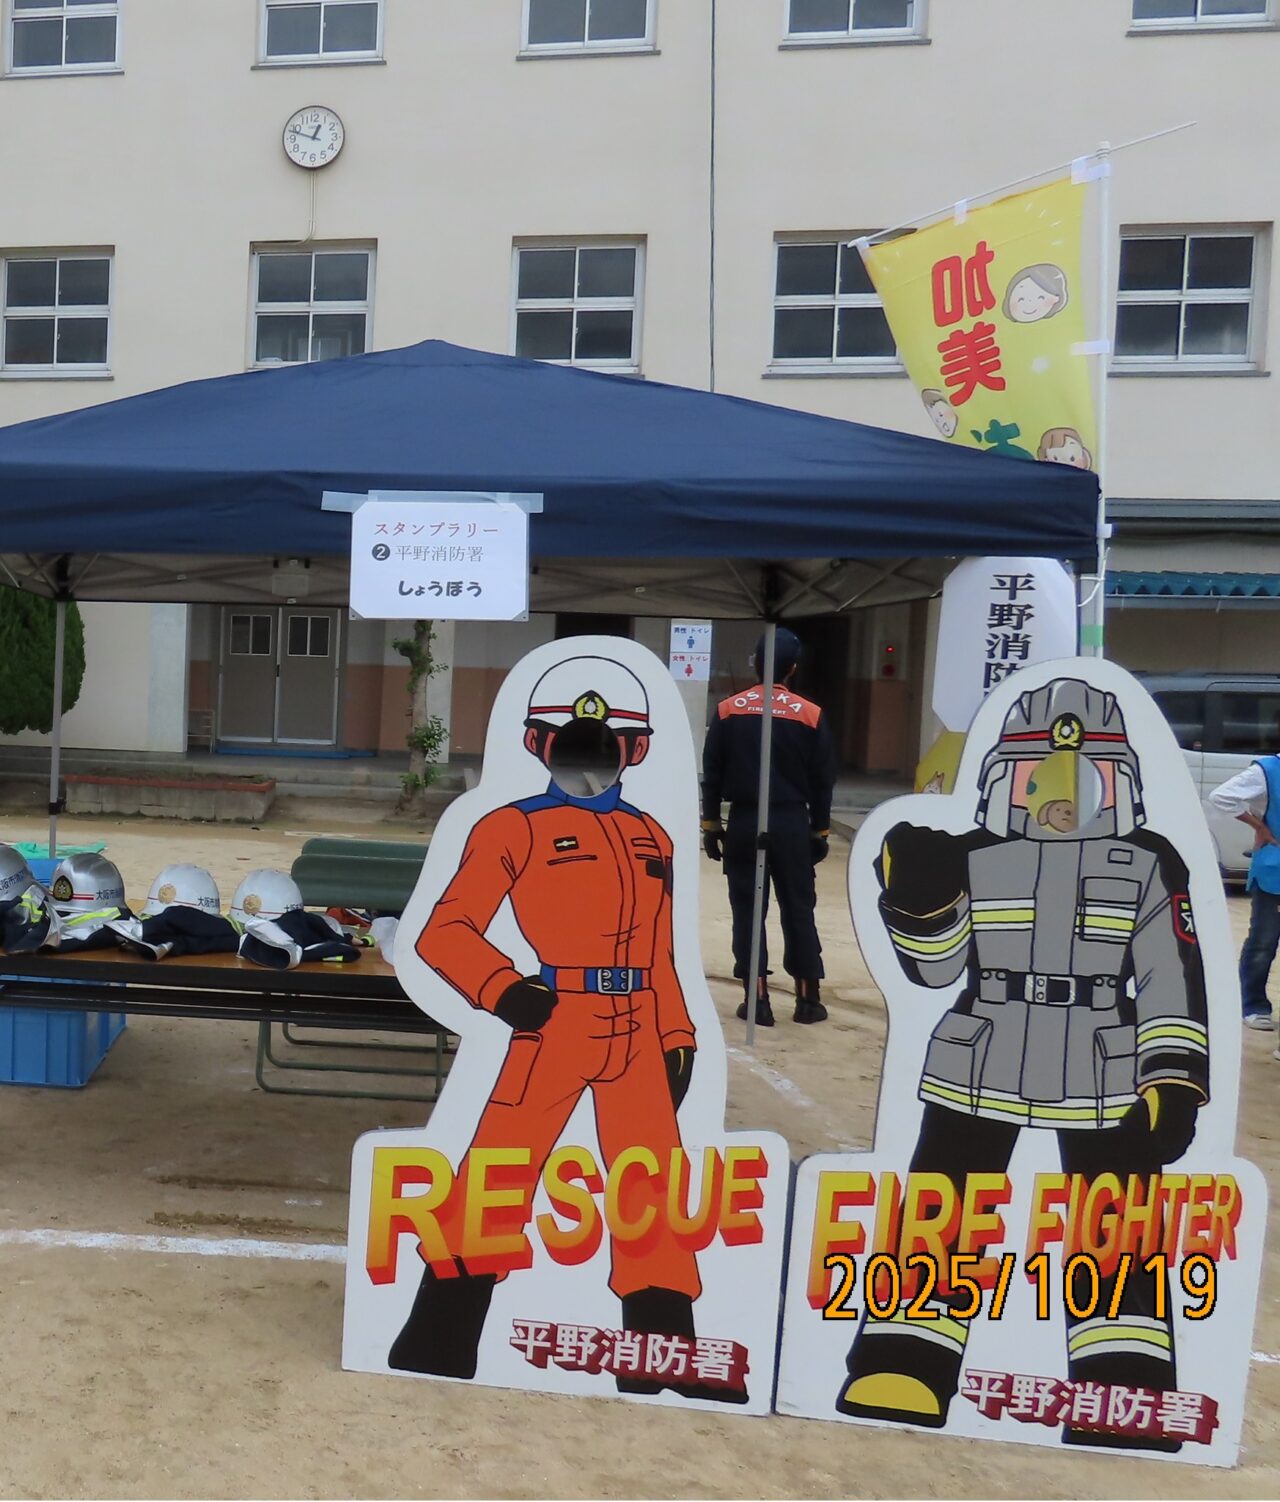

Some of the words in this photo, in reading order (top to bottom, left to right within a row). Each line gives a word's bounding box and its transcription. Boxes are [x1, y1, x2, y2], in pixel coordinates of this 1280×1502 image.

[310, 113, 320, 123] 12
[328, 122, 336, 131] 2
[289, 134, 297, 143] 9
[331, 132, 338, 142] 3
[292, 143, 300, 153] 8
[327, 142, 335, 151] 4
[300, 151, 307, 160] 7
[309, 153, 317, 162] 6
[320, 150, 327, 160] 5
[373, 521, 499, 538] スタンプラリー
[398, 580, 483, 598] しょうぼう
[983, 572, 1036, 699] 平野消防
[734, 691, 803, 713] OSKA
[366, 1145, 768, 1285] RESCUE
[807, 1170, 1013, 1310] FIRE
[1025, 1171, 1243, 1285] FIGHTER
[509, 1318, 740, 1385] 平野消防署
[961, 1368, 1210, 1440] 平野消防署
